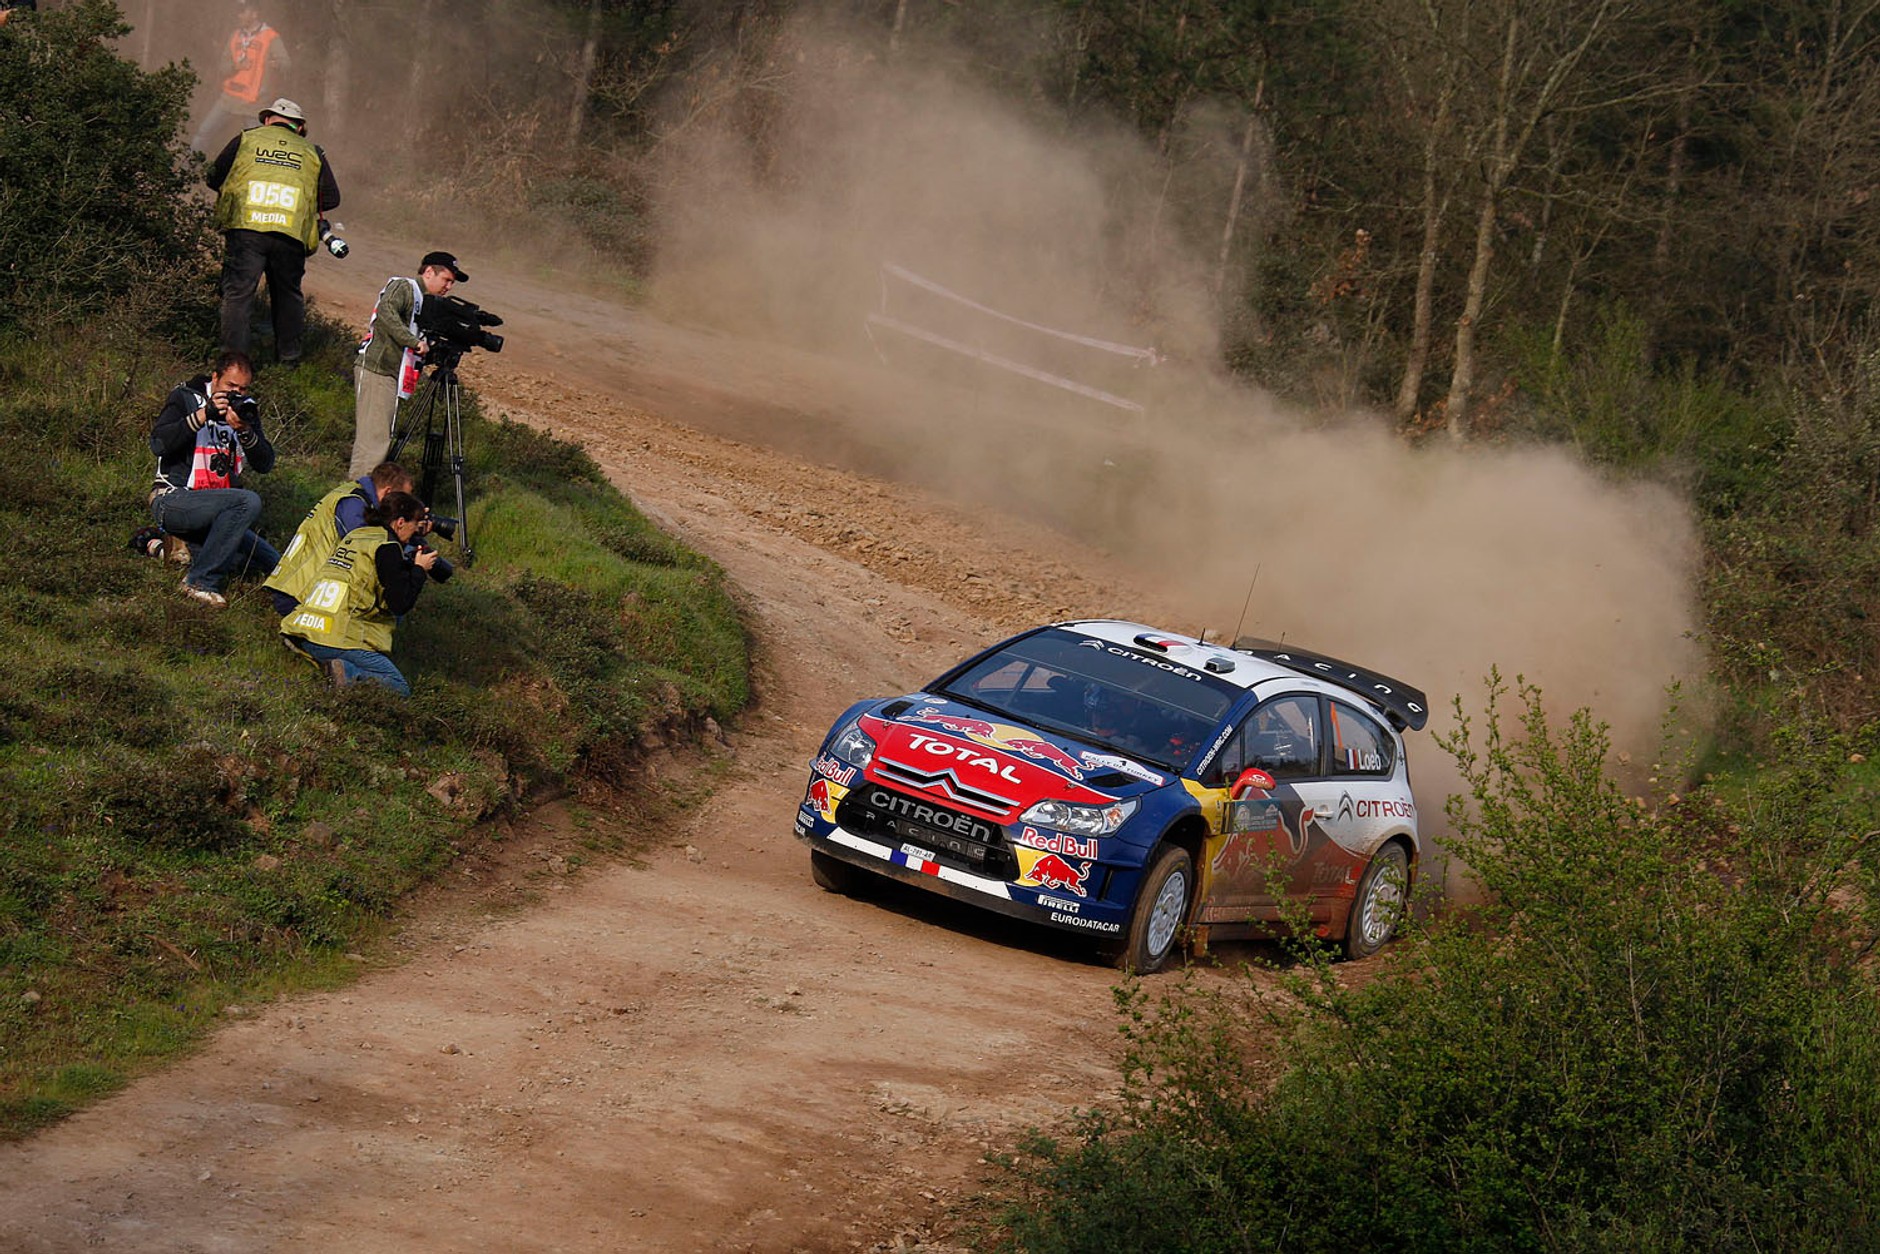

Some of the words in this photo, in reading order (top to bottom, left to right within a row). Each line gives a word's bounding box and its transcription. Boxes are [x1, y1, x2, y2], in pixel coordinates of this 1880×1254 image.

[250, 182, 296, 208] 056
[251, 211, 287, 225] MEDIA
[909, 733, 1022, 785] TOTAL
[1358, 748, 1381, 771] Loeb
[824, 761, 857, 787] Bull
[1022, 826, 1063, 854] Red
[1062, 836, 1098, 860] Bull
[1312, 861, 1356, 885] TOTAL
[1038, 894, 1080, 914] PIRELLI
[1051, 912, 1121, 932] EURODATACAR
